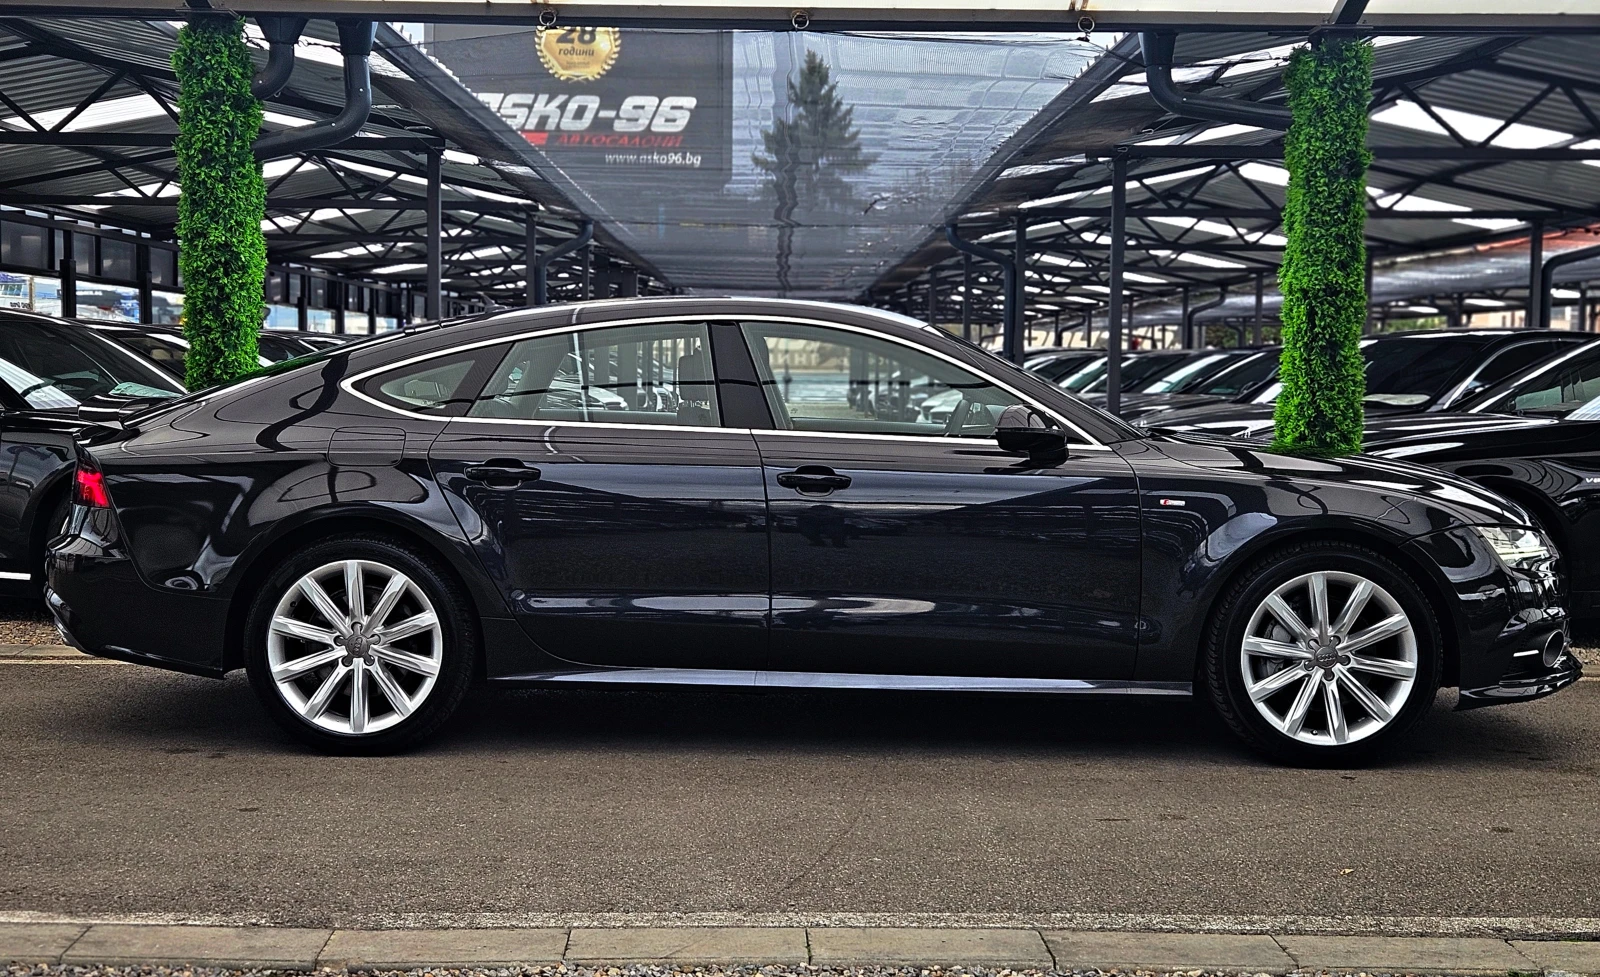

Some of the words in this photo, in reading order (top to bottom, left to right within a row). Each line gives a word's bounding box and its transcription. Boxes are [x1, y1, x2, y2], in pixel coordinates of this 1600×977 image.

[556, 27, 597, 45] 28
[558, 46, 595, 57] години
[557, 133, 684, 148] АВТОСАЛОНИ
[605, 152, 702, 168] www.asko96.bg
